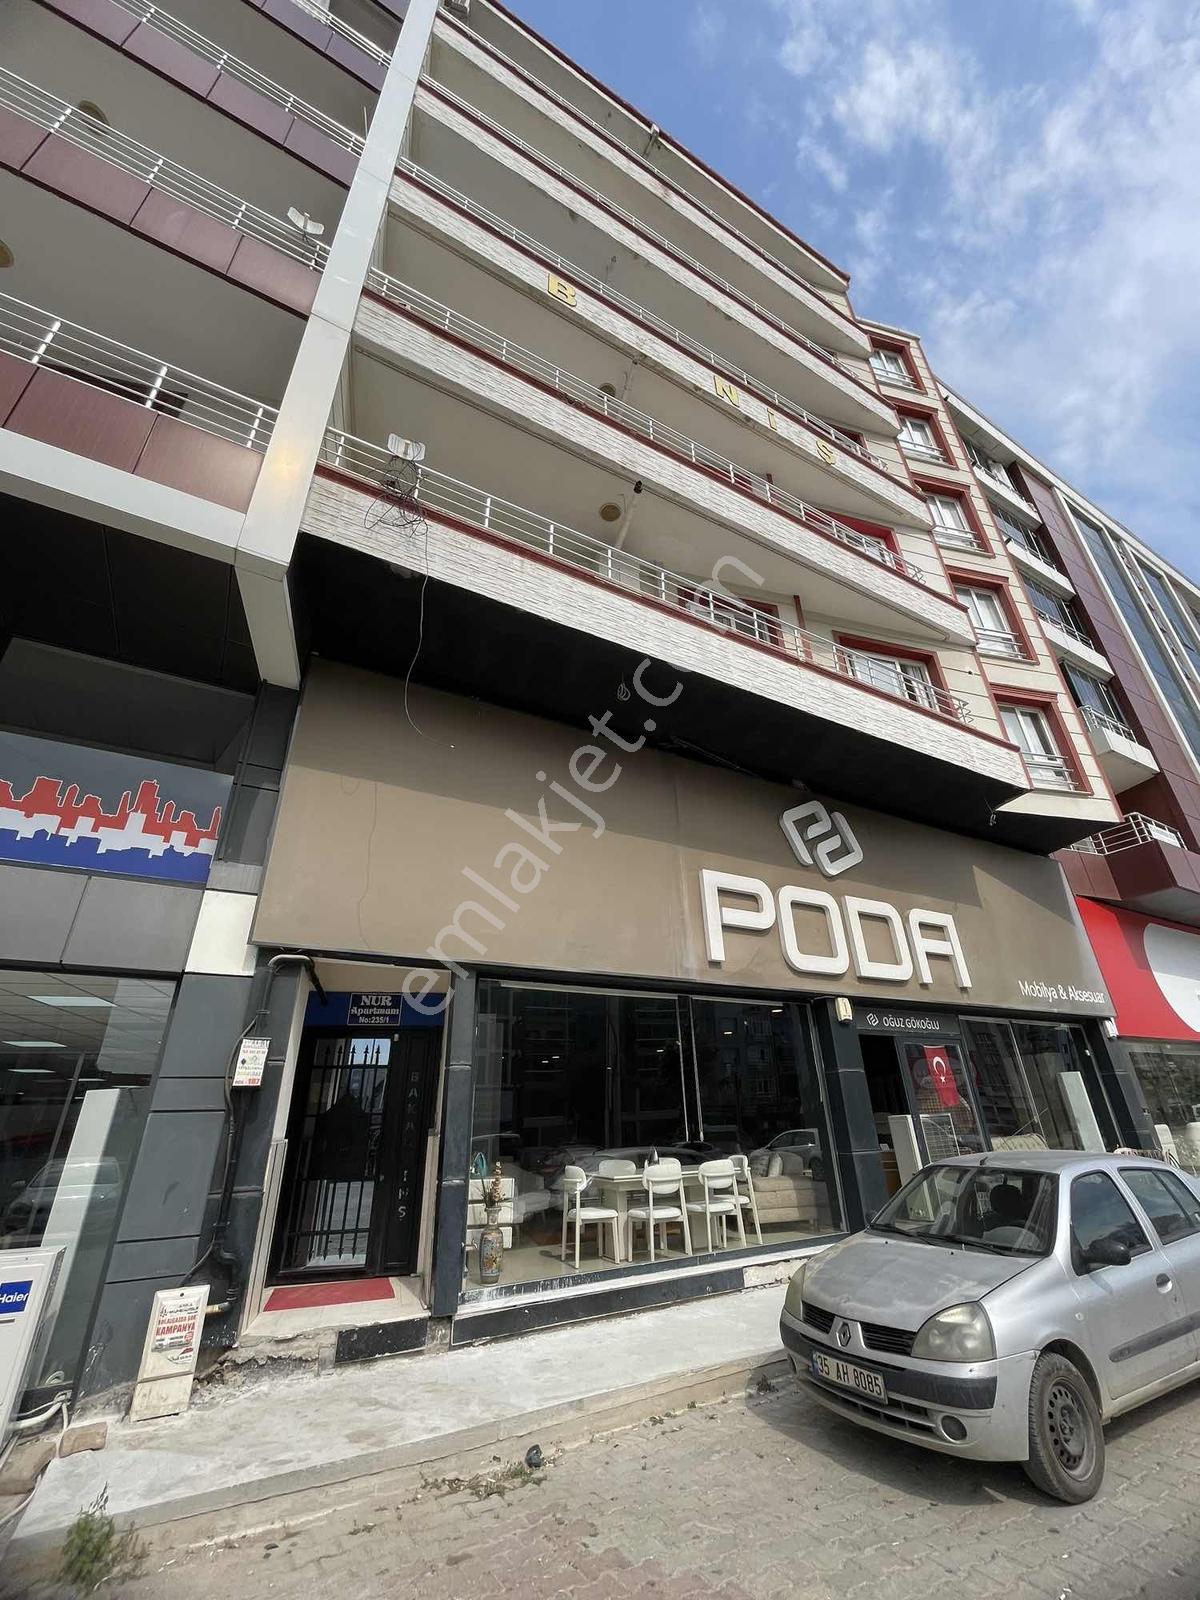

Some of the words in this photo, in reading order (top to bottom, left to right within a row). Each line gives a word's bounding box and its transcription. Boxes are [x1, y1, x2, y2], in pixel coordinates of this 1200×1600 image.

[702, 869, 972, 988] PODA
[1018, 980, 1058, 1002] Mobilya
[1057, 984, 1068, 999] &
[1068, 985, 1105, 1003] Aksesuar
[360, 995, 392, 1006] NUR
[883, 1015, 905, 1028] OĞUZ
[905, 1017, 940, 1030] GÖKOĞLU
[0, 1292, 28, 1303] Haier
[155, 1321, 196, 1337] KAMPANYA
[816, 1354, 830, 1376] 35
[836, 1362, 850, 1384] AH
[853, 1368, 882, 1396] 8085
